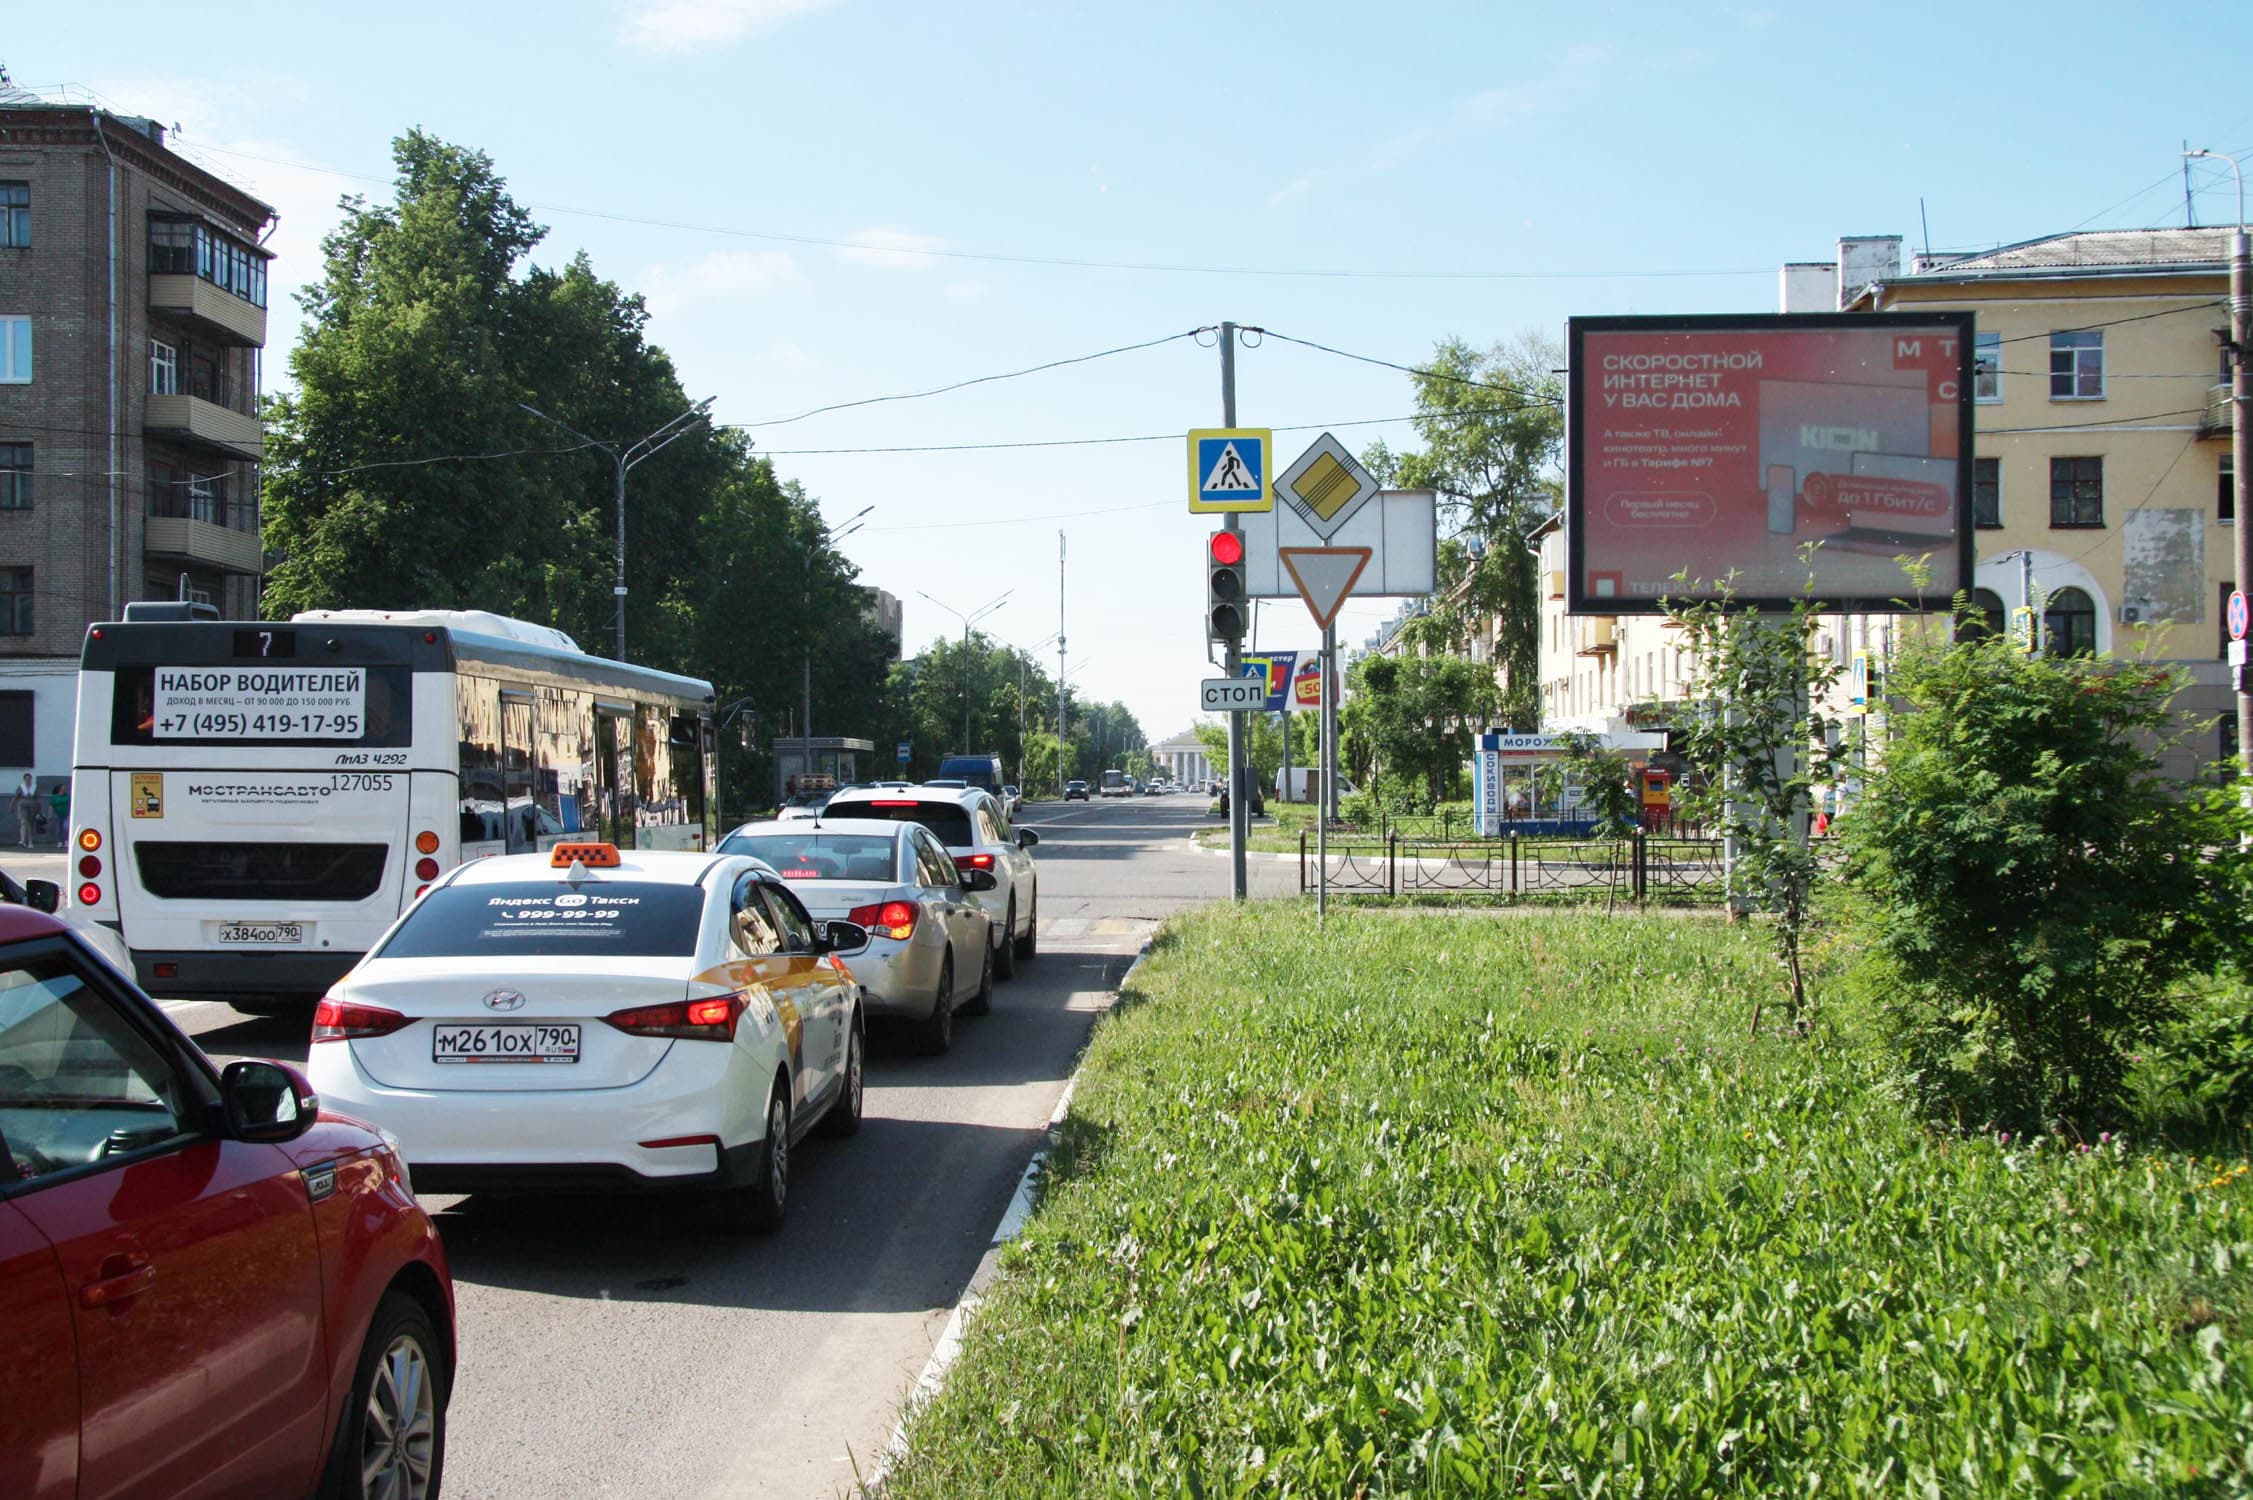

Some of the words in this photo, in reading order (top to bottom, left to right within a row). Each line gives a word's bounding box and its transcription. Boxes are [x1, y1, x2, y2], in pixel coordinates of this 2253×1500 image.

[1603, 350, 1763, 370] СКОРОСТНОЙ
[1603, 374, 1723, 389] ИНТЕРНЕТ
[1604, 394, 1618, 408] У
[1622, 392, 1667, 408] ВАС
[1672, 392, 1742, 410] ДОМА
[260, 632, 272, 656] 7
[160, 674, 231, 692] НАБОР
[238, 670, 360, 694] ВОДИТЕЛЕЙ
[166, 698, 196, 706] ДОХОД
[199, 698, 204, 706] В
[206, 698, 234, 706] МЕСЯЦ
[244, 698, 254, 706] ОТ
[257, 698, 267, 706] 90
[269, 698, 284, 706] 000
[286, 698, 298, 706] ДО
[302, 698, 316, 706] 150
[318, 698, 333, 706] 000
[1206, 686, 1260, 703] СТОП
[160, 714, 187, 732] +7
[194, 714, 247, 735] (495)
[253, 714, 358, 732] 419-17-95
[374, 754, 407, 765] 4292
[189, 786, 331, 796] МОСТРАНСАВТО
[331, 774, 393, 792] 127055
[488, 898, 552, 906] Яндекс
[591, 896, 640, 905] Такси
[518, 910, 620, 918] 999-99-99
[224, 928, 276, 940] Х384ОО
[278, 927, 298, 936] 790
[442, 1030, 532, 1052] М261ОХ
[538, 1028, 572, 1046] 790
